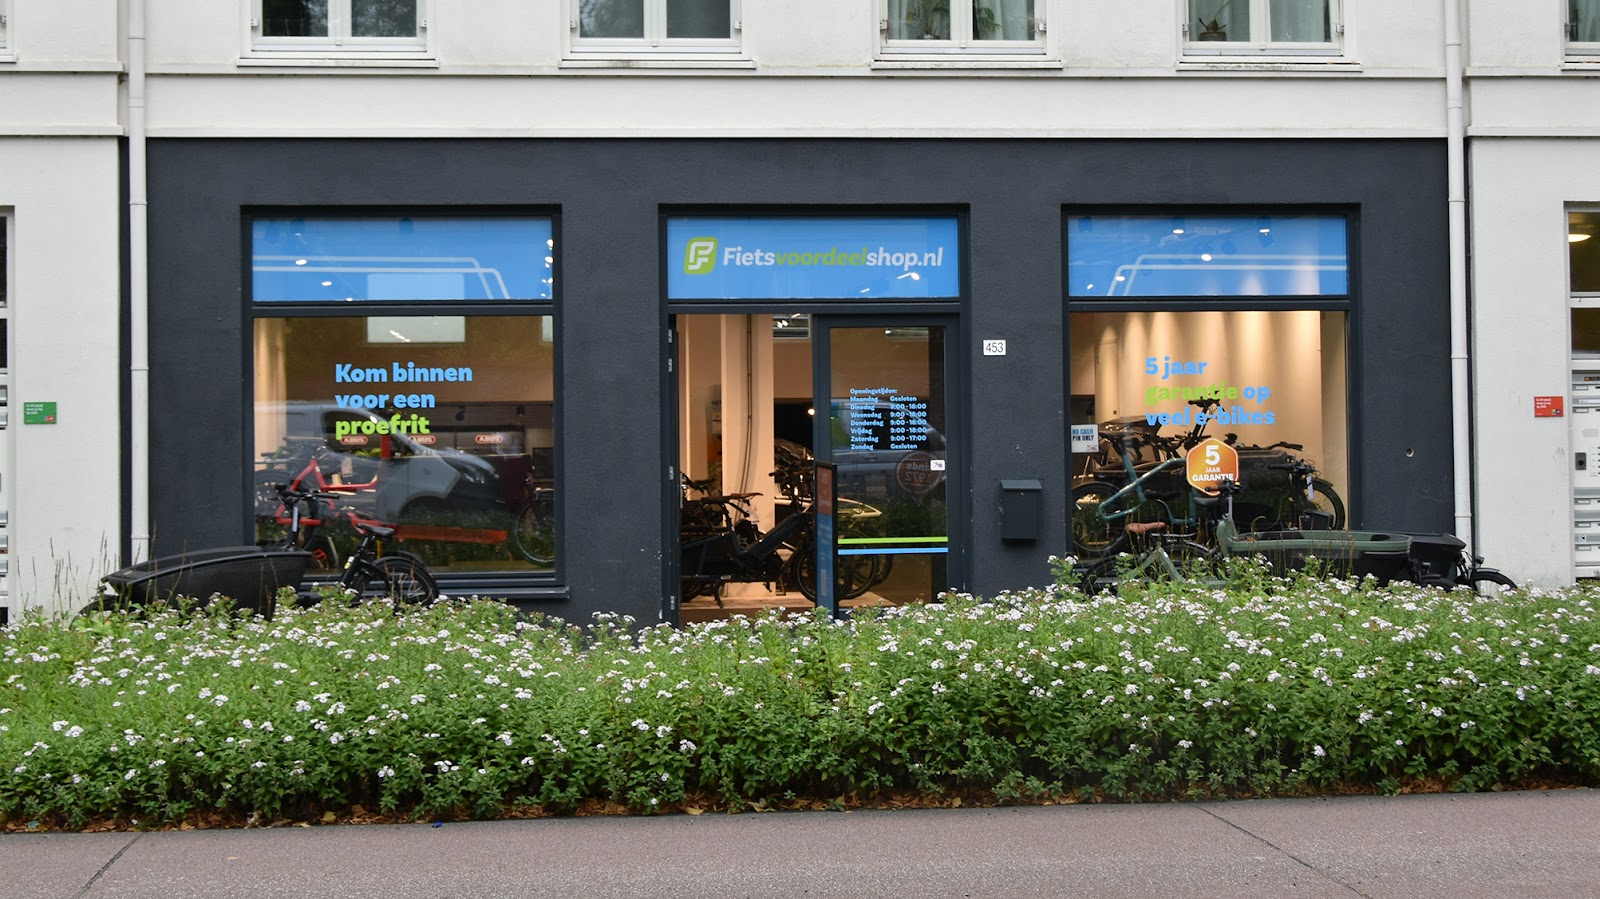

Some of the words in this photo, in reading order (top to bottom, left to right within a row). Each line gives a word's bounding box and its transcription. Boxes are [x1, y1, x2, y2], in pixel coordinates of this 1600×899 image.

[723, 246, 943, 271] Fietsvoordeelshop.nl
[985, 341, 1004, 353] 453
[335, 363, 387, 383] Kom
[392, 361, 473, 382] binnen
[1145, 357, 1158, 375] 5
[1161, 356, 1208, 380] jaar
[334, 394, 390, 409] voor
[393, 393, 436, 408] een
[850, 387, 898, 395] Openingstijden:
[1145, 380, 1238, 406] garantie
[1243, 385, 1271, 405] op
[1145, 406, 1191, 426] veel
[1195, 405, 1276, 426] e-bikes
[335, 413, 430, 441] proefrit
[1205, 444, 1220, 466] 5
[1192, 473, 1234, 482] GARANTIE
